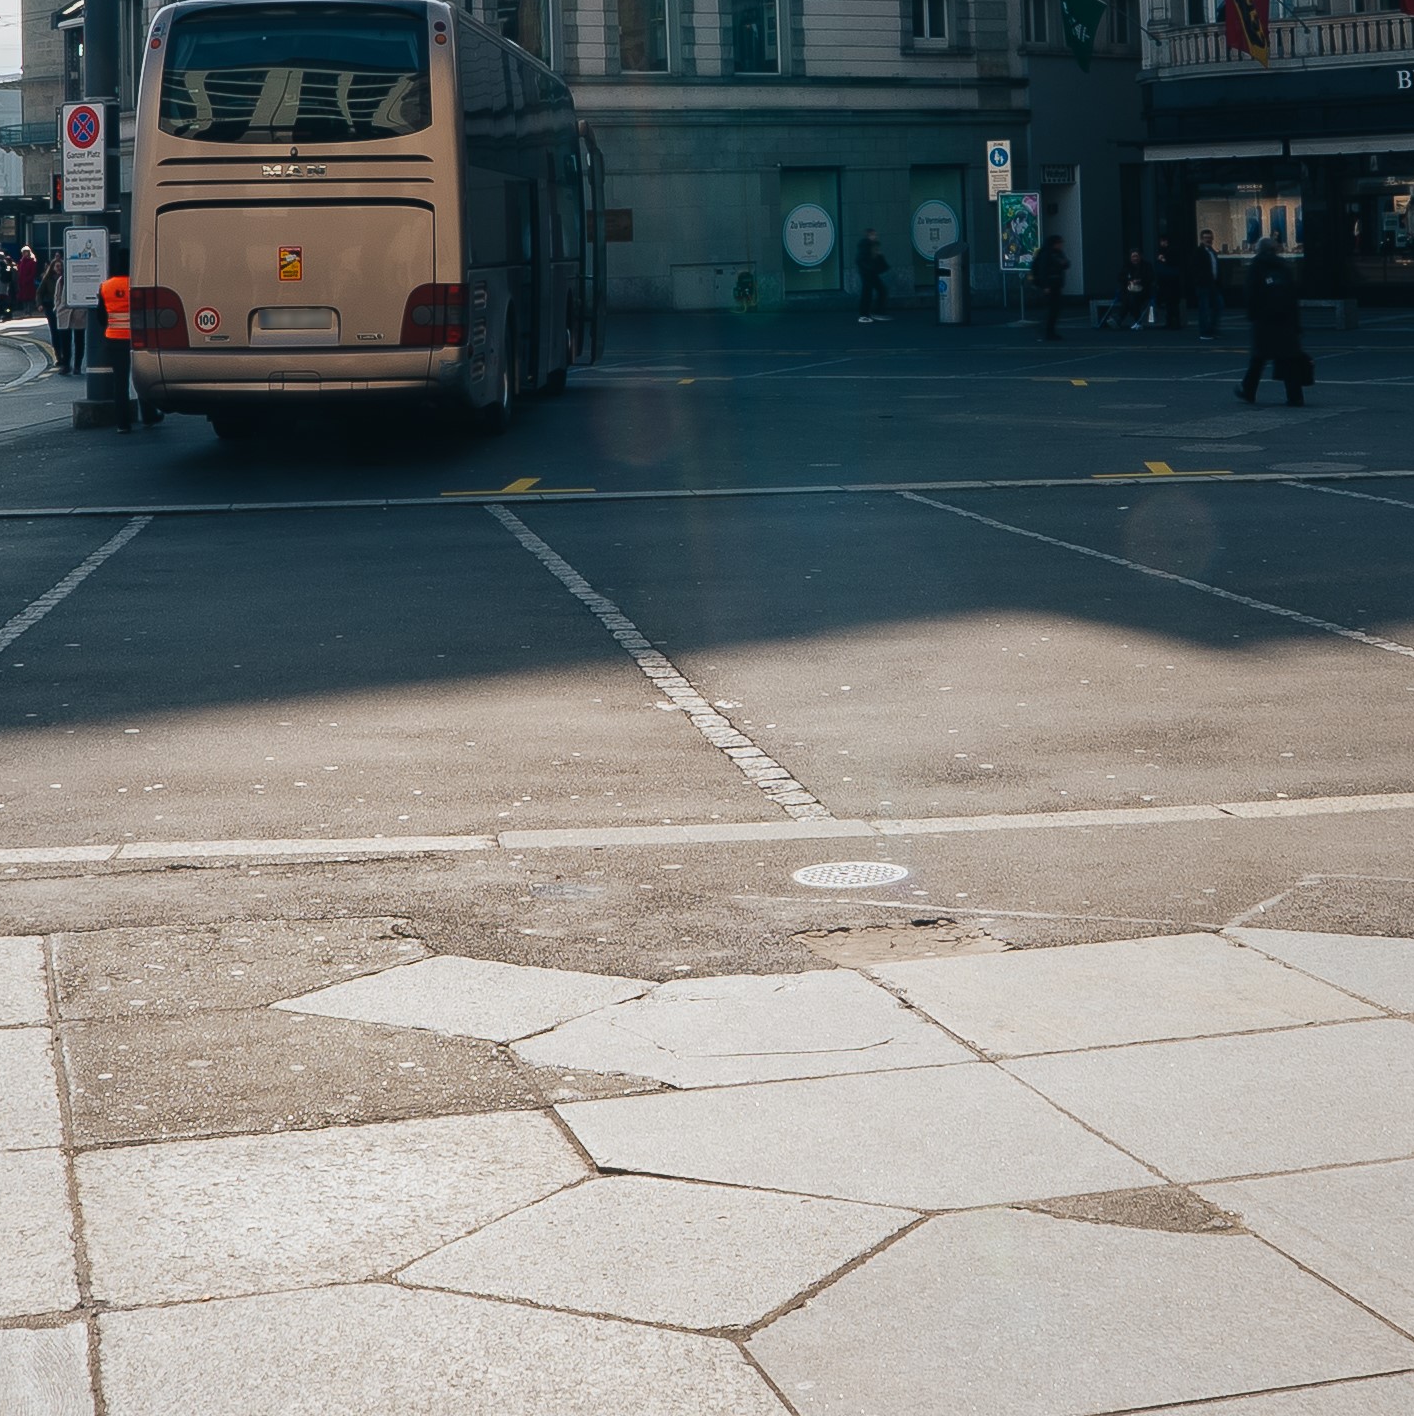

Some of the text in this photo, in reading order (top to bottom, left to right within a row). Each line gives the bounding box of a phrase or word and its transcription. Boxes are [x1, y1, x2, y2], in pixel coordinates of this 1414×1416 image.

[66, 150, 101, 160] Ganzer Platz
[261, 164, 327, 177] MAN
[790, 220, 827, 229] Zu Vermieten
[917, 216, 952, 225] Zu Vermieten
[198, 314, 216, 326] 100
